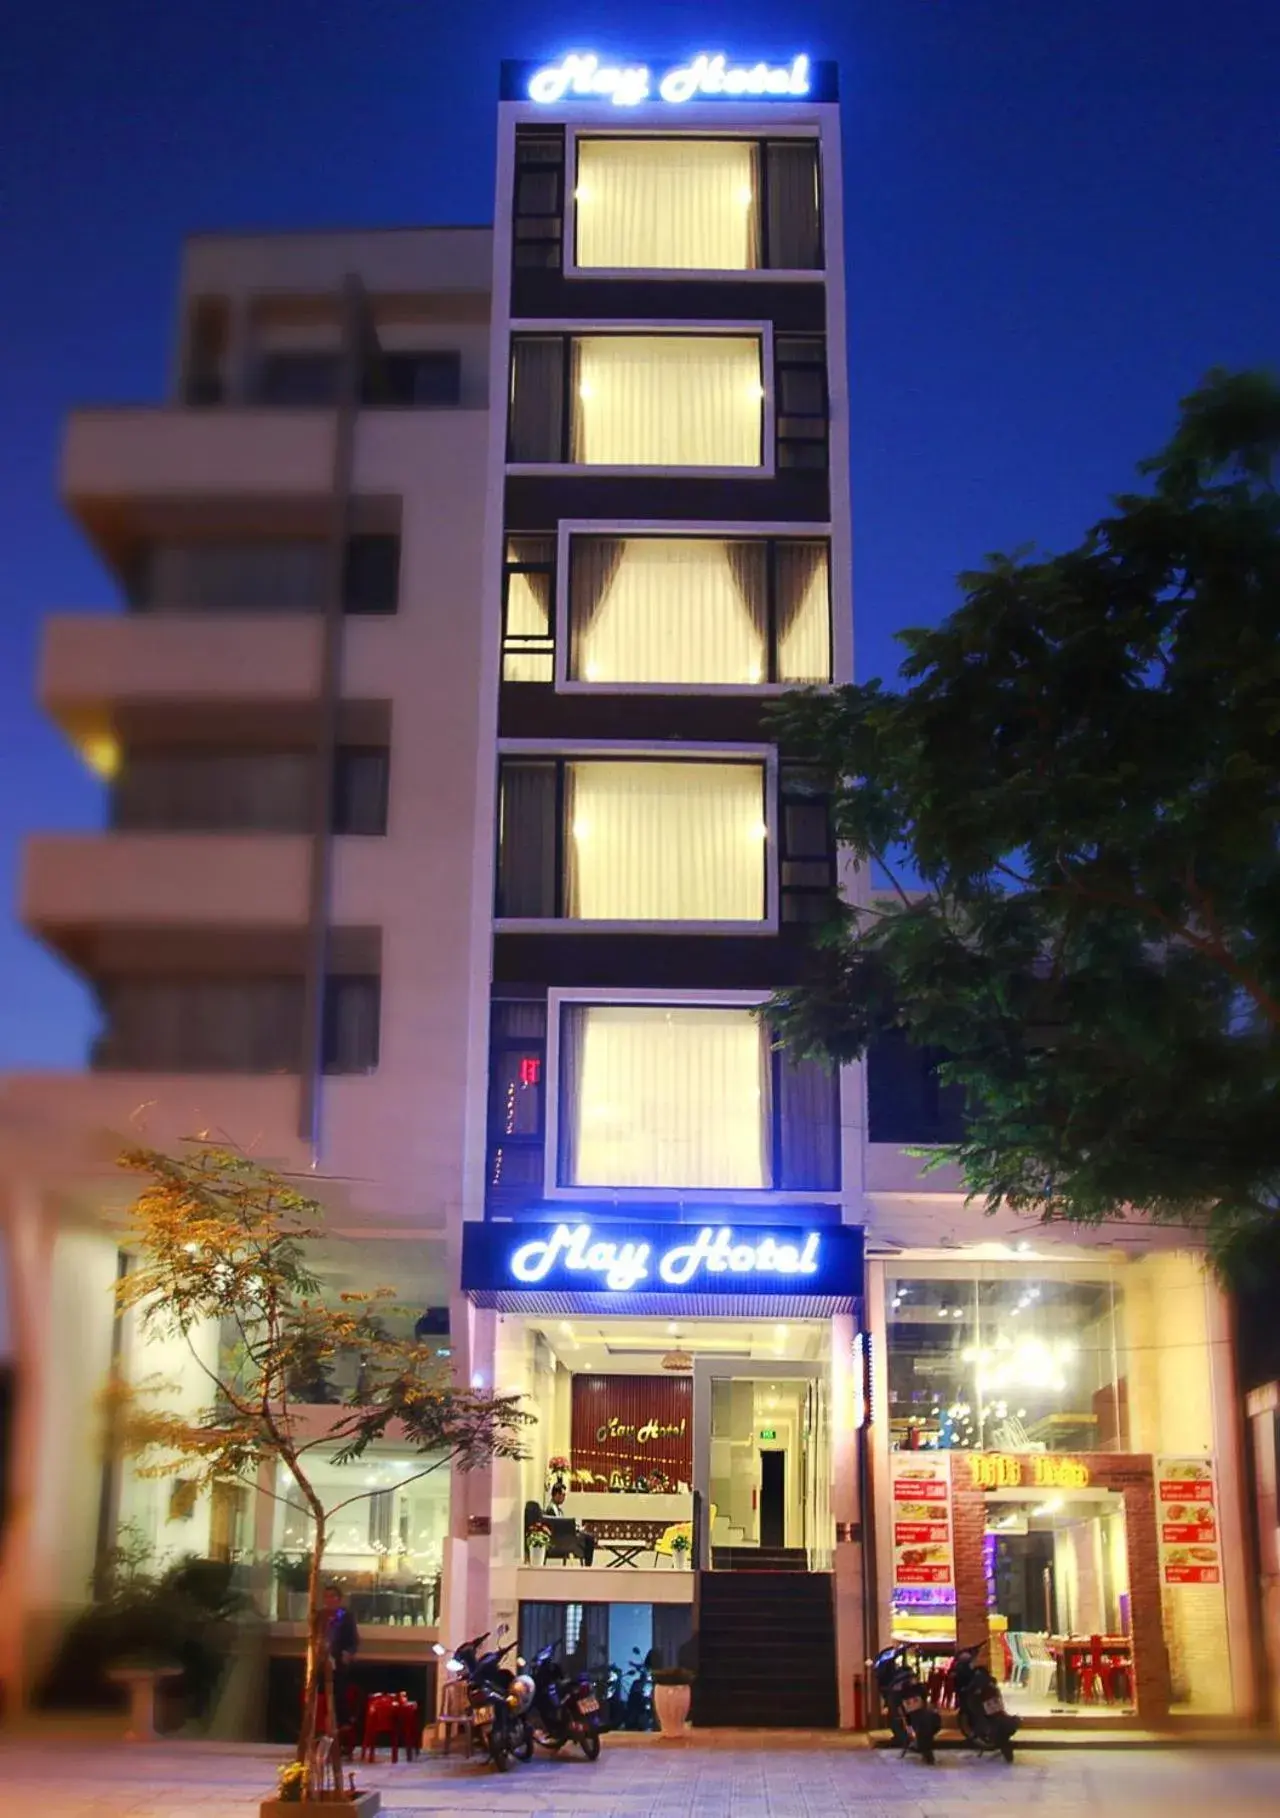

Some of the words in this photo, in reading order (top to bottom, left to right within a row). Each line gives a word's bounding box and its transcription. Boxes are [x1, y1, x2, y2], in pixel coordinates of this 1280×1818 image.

[528, 54, 649, 105] May
[659, 53, 811, 103] Hotel
[511, 1224, 649, 1290] May
[658, 1226, 820, 1285] Hotel
